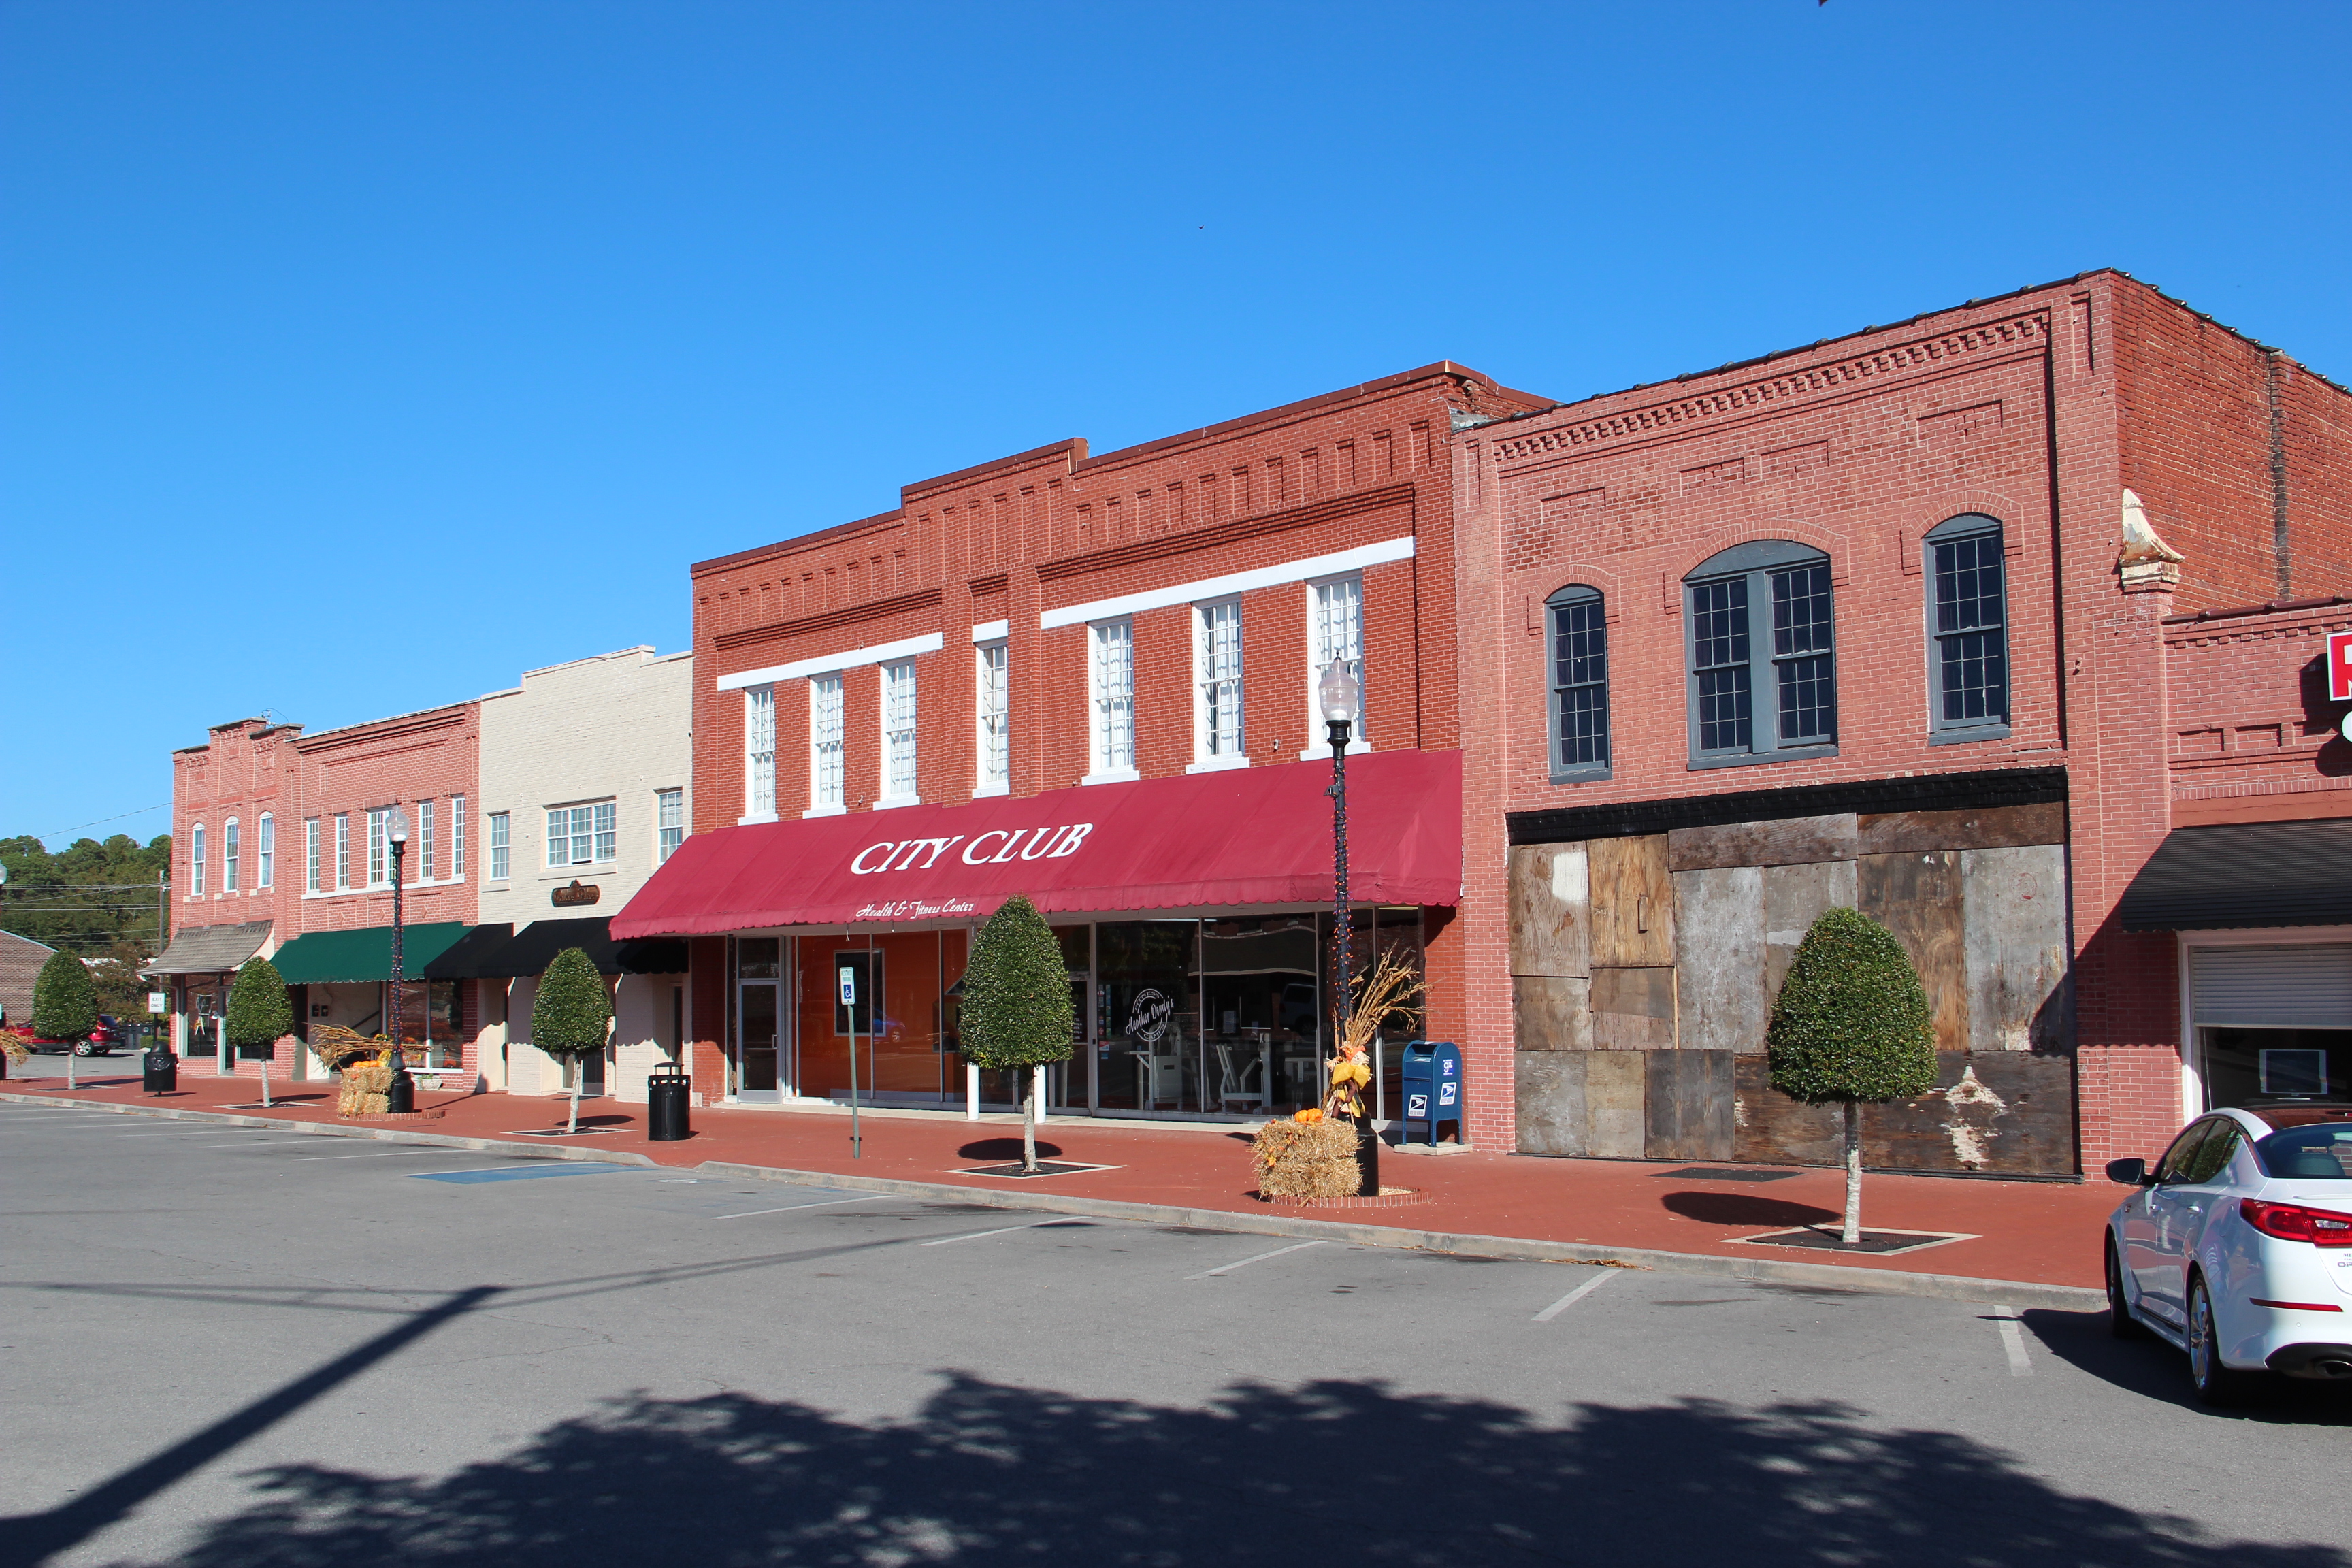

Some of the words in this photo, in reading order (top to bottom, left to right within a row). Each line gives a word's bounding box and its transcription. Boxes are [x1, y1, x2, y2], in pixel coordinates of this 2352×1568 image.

[851, 834, 965, 875] CITY
[962, 823, 1094, 866] CLUB
[855, 901, 896, 917] Health
[894, 900, 908, 916] &
[909, 900, 941, 919] Fitness
[942, 898, 975, 913] Center
[1126, 1011, 1150, 1035] Heather
[1151, 995, 1174, 1019] Dendy's
[1134, 991, 1160, 1011] FITNESS
